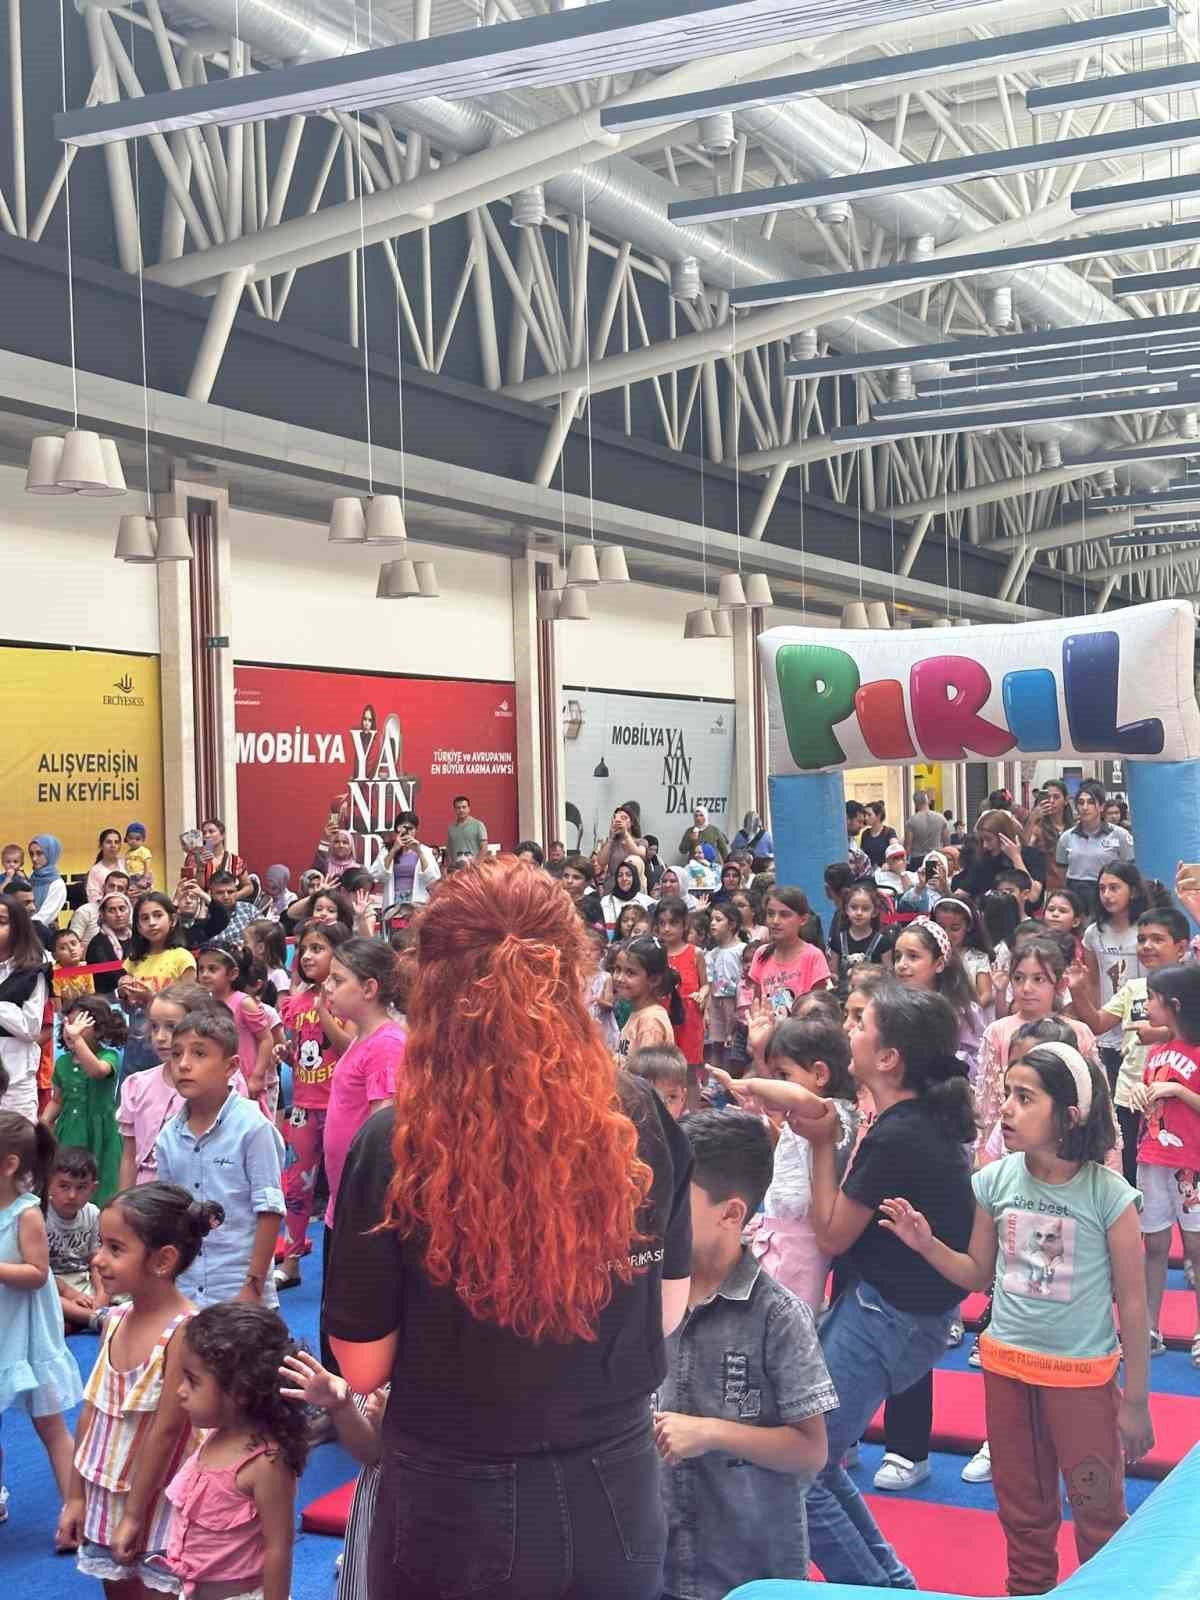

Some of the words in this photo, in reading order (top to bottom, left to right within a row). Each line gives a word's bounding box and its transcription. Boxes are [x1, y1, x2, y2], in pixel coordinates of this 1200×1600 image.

[235, 725, 346, 764] MOBİLYA
[349, 729, 401, 781] YA
[433, 747, 462, 762] TÜRKİYE
[471, 751, 512, 762] AVRUPA'NIN
[612, 722, 664, 746] MOBİLYA
[665, 728, 685, 758] YA
[38, 748, 139, 779] ALIŞVERİŞİN
[431, 763, 441, 775] EN
[442, 760, 466, 775] BÜYÜK
[466, 763, 491, 775] KARMA
[661, 756, 693, 785] NIN
[38, 782, 61, 802] EN
[66, 776, 140, 802] KEYİFLİSİ
[665, 785, 689, 814] DA
[347, 781, 417, 833] NIN
[1014, 1195, 1034, 1210] the
[1038, 1200, 1071, 1217] best
